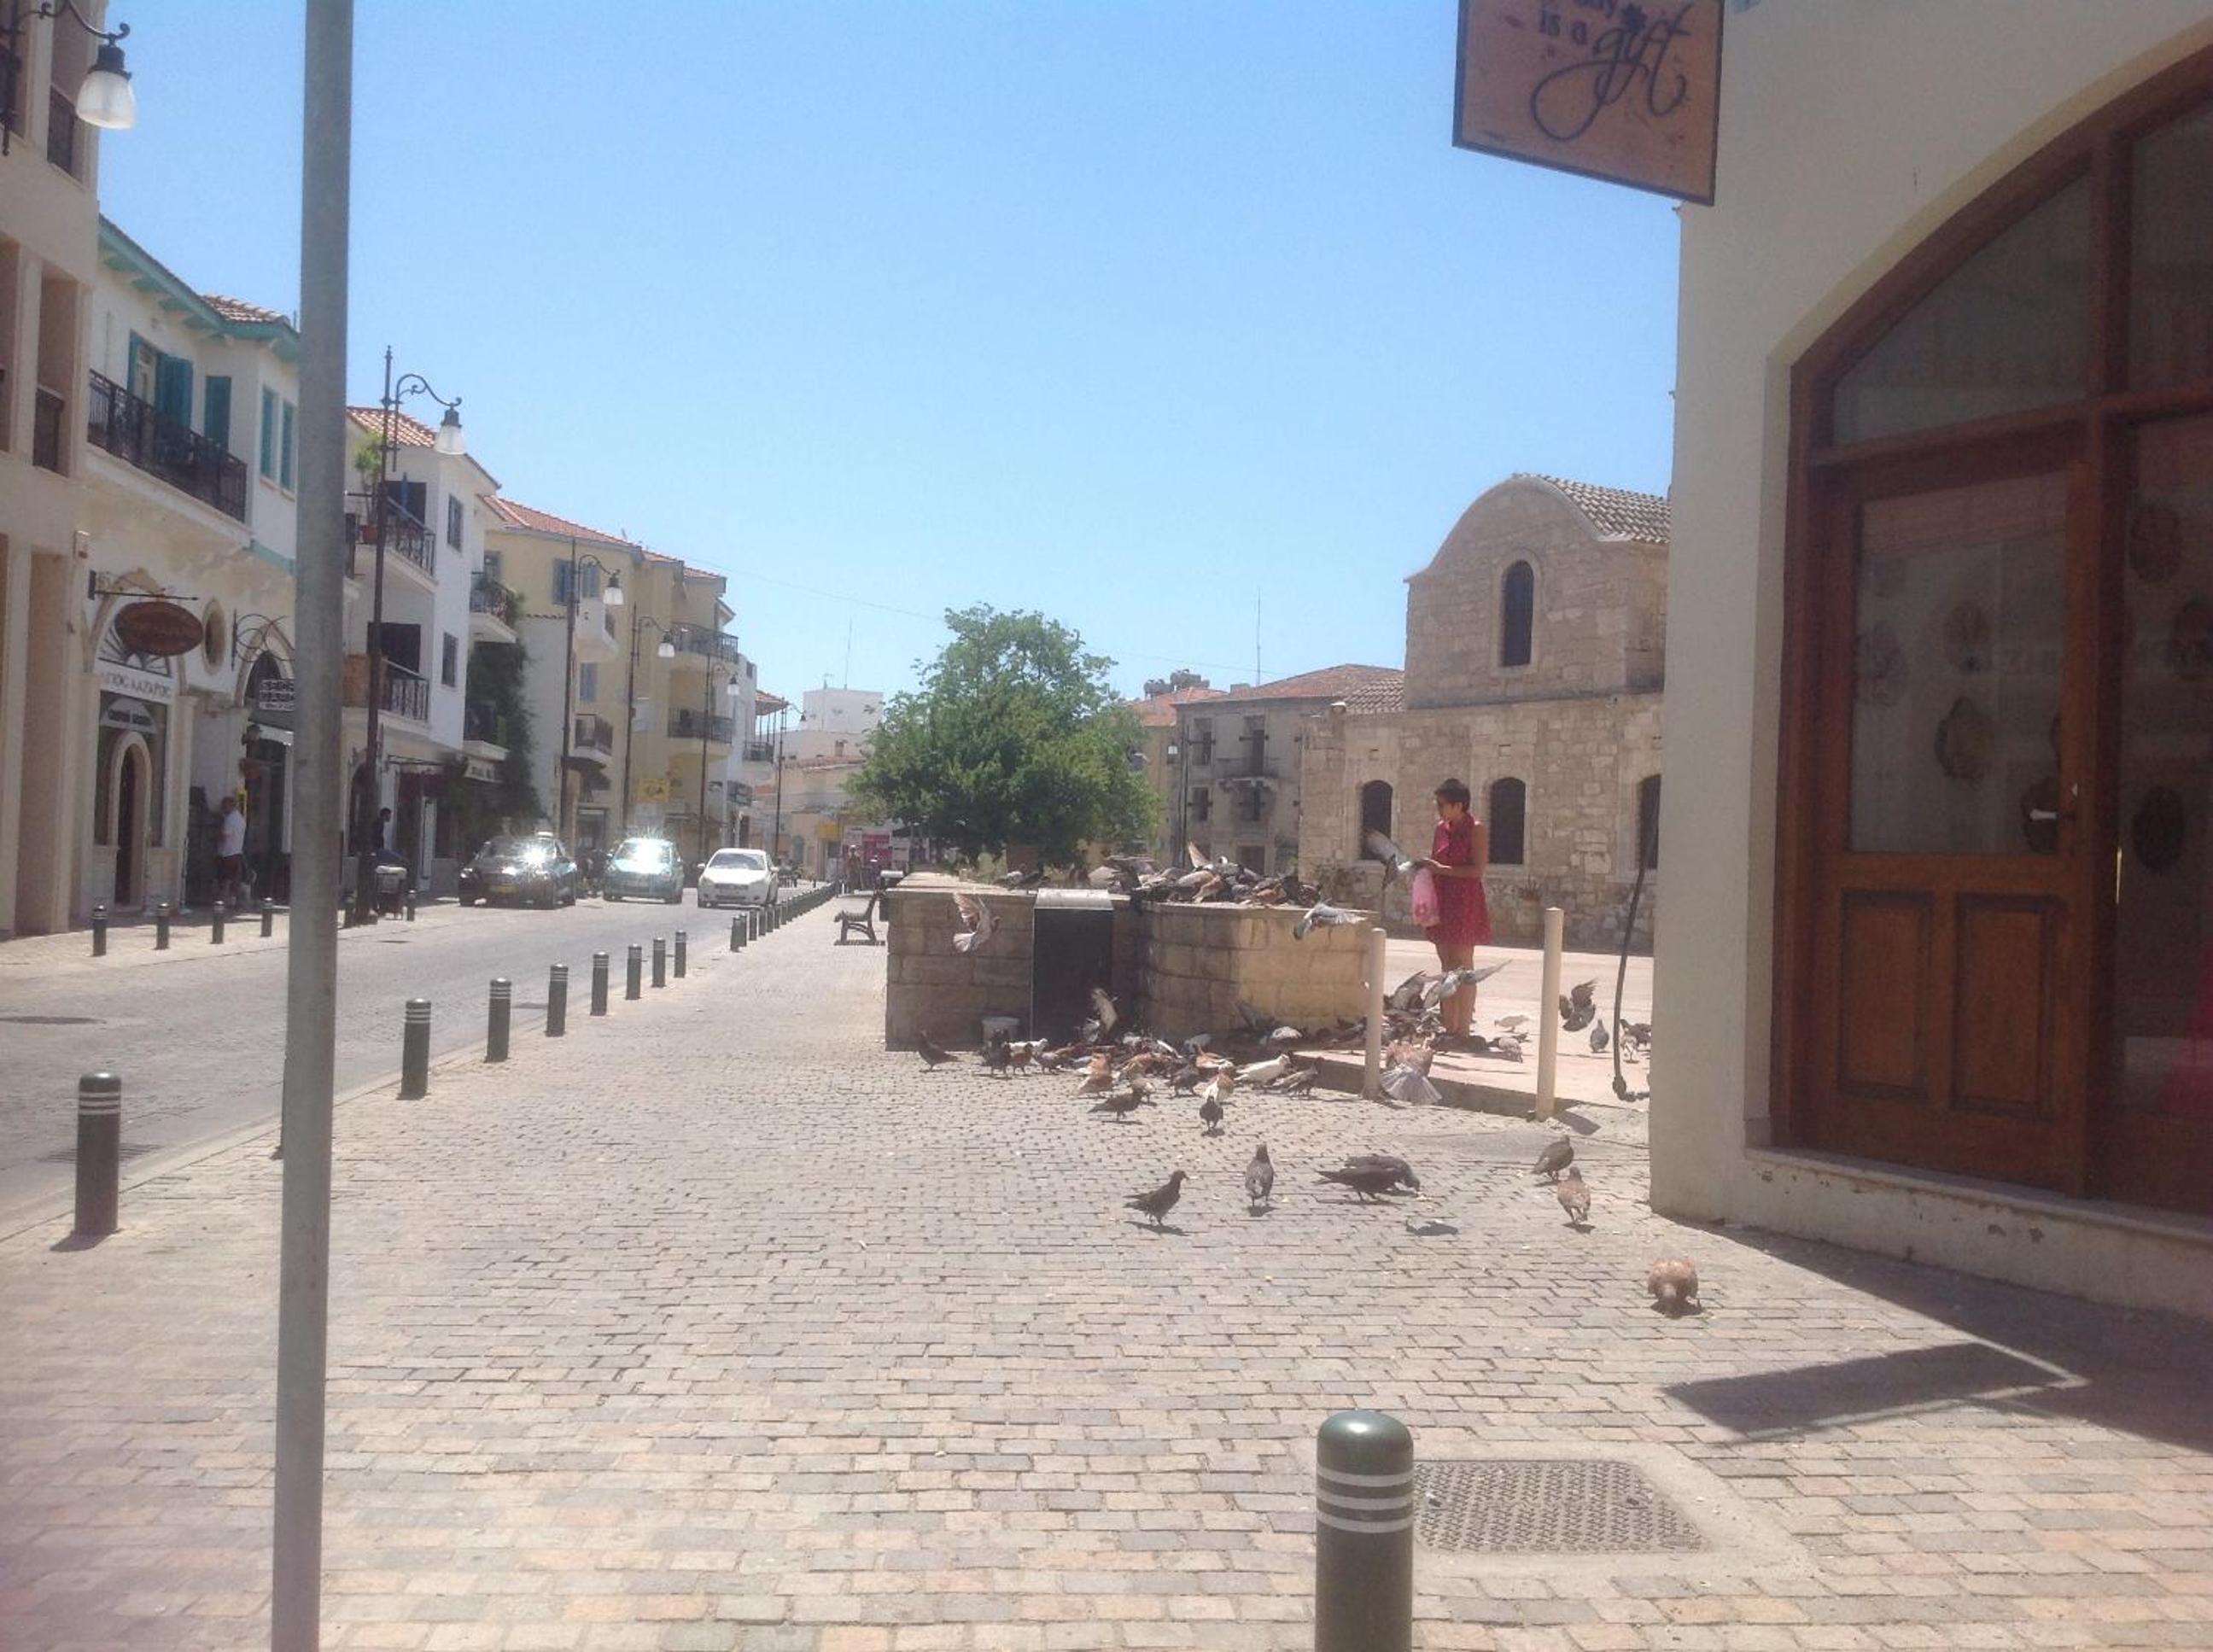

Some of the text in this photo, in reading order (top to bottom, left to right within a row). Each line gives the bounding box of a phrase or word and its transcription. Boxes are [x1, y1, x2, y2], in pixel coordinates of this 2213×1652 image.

[1539, 9, 1561, 37] is
[1571, 20, 1588, 45] a
[1530, 2, 1694, 142] gift
